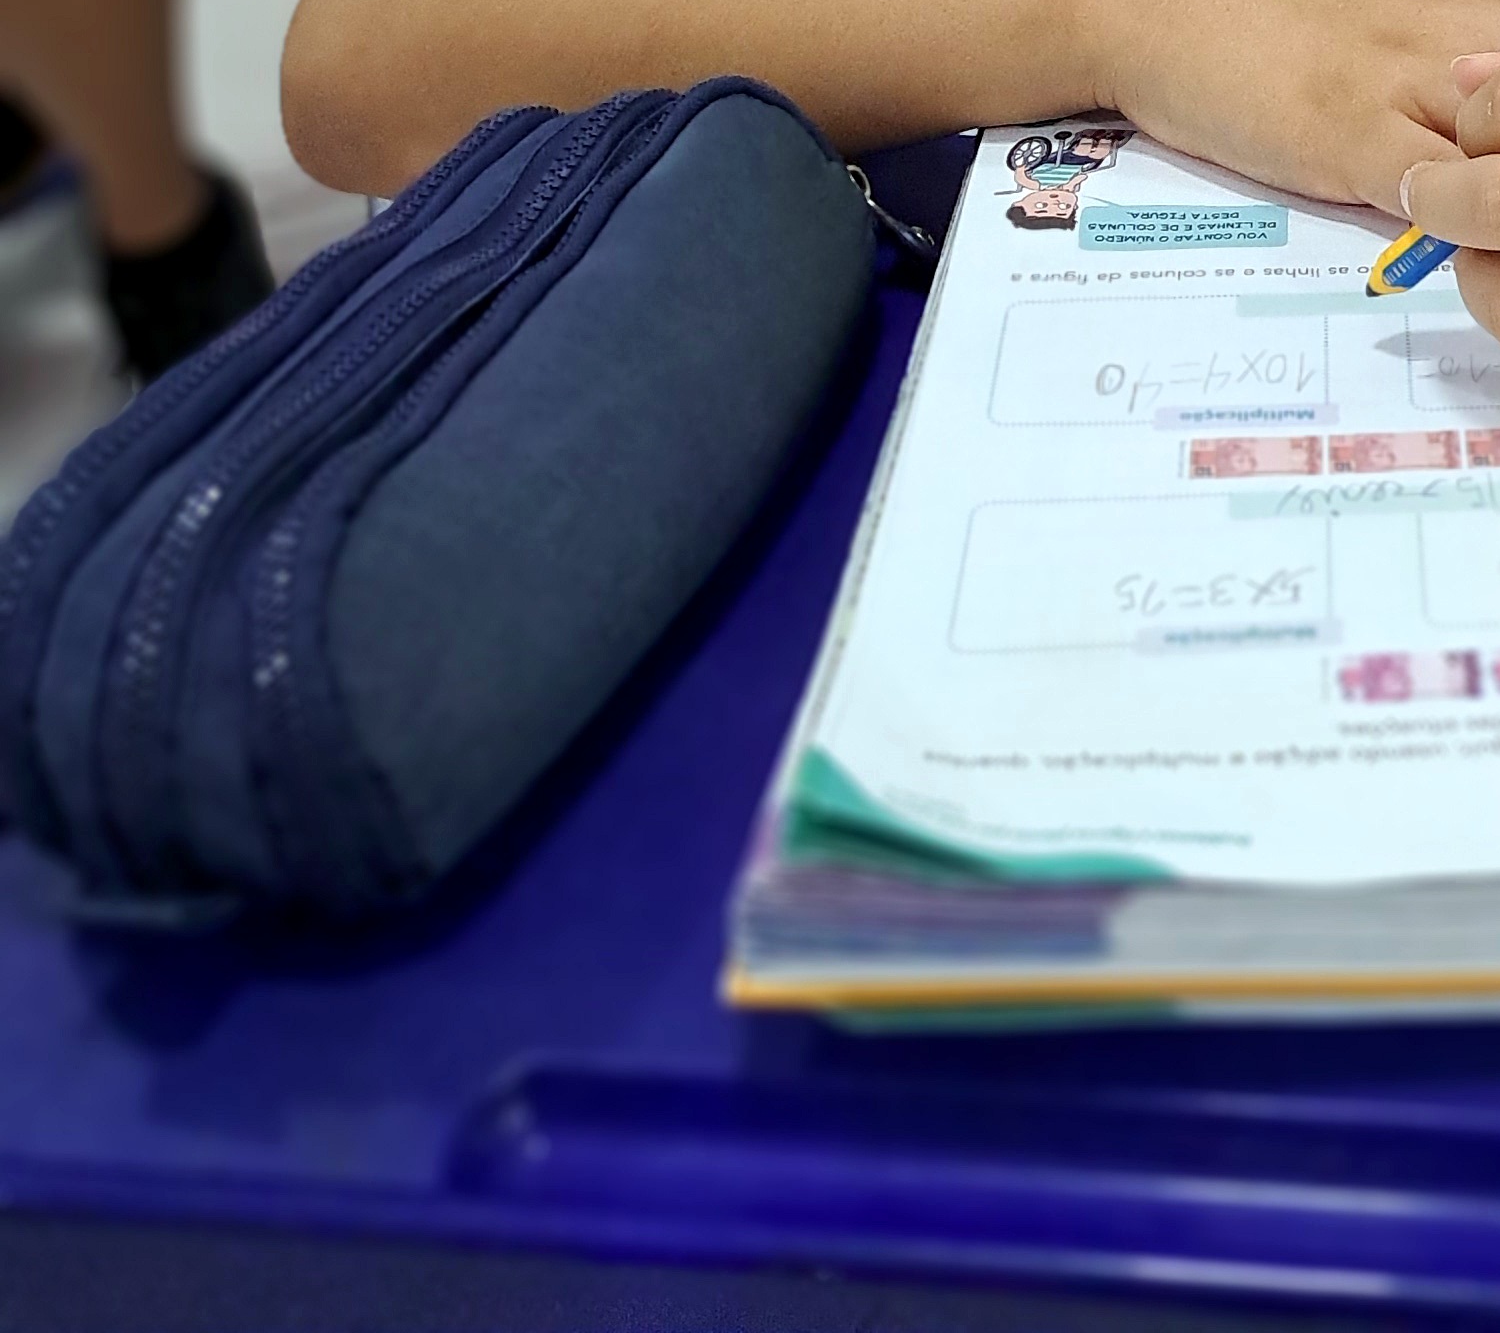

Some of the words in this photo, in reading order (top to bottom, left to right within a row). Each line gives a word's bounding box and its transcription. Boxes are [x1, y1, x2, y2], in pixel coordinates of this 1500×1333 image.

[1190, 211, 1239, 220] DESTA
[1088, 223, 1156, 232] COLUNAS
[1160, 223, 1179, 232] DE
[1183, 224, 1193, 232] E
[1197, 222, 1253, 231] LINHAS
[1258, 221, 1277, 229] DE
[1094, 234, 1155, 245] NÚMERO
[1159, 235, 1169, 243] O
[1174, 233, 1232, 242] CONTAR
[1237, 232, 1267, 240] VOU
[1129, 269, 1207, 281] colunas
[1215, 268, 1235, 278] as
[1243, 268, 1255, 277] e
[1263, 267, 1320, 278] linhas
[1328, 266, 1349, 276] as
[1010, 273, 1023, 284] a
[1030, 271, 1089, 286] figura
[1097, 272, 1121, 283] da
[1179, 408, 1315, 423] Multiplicação
